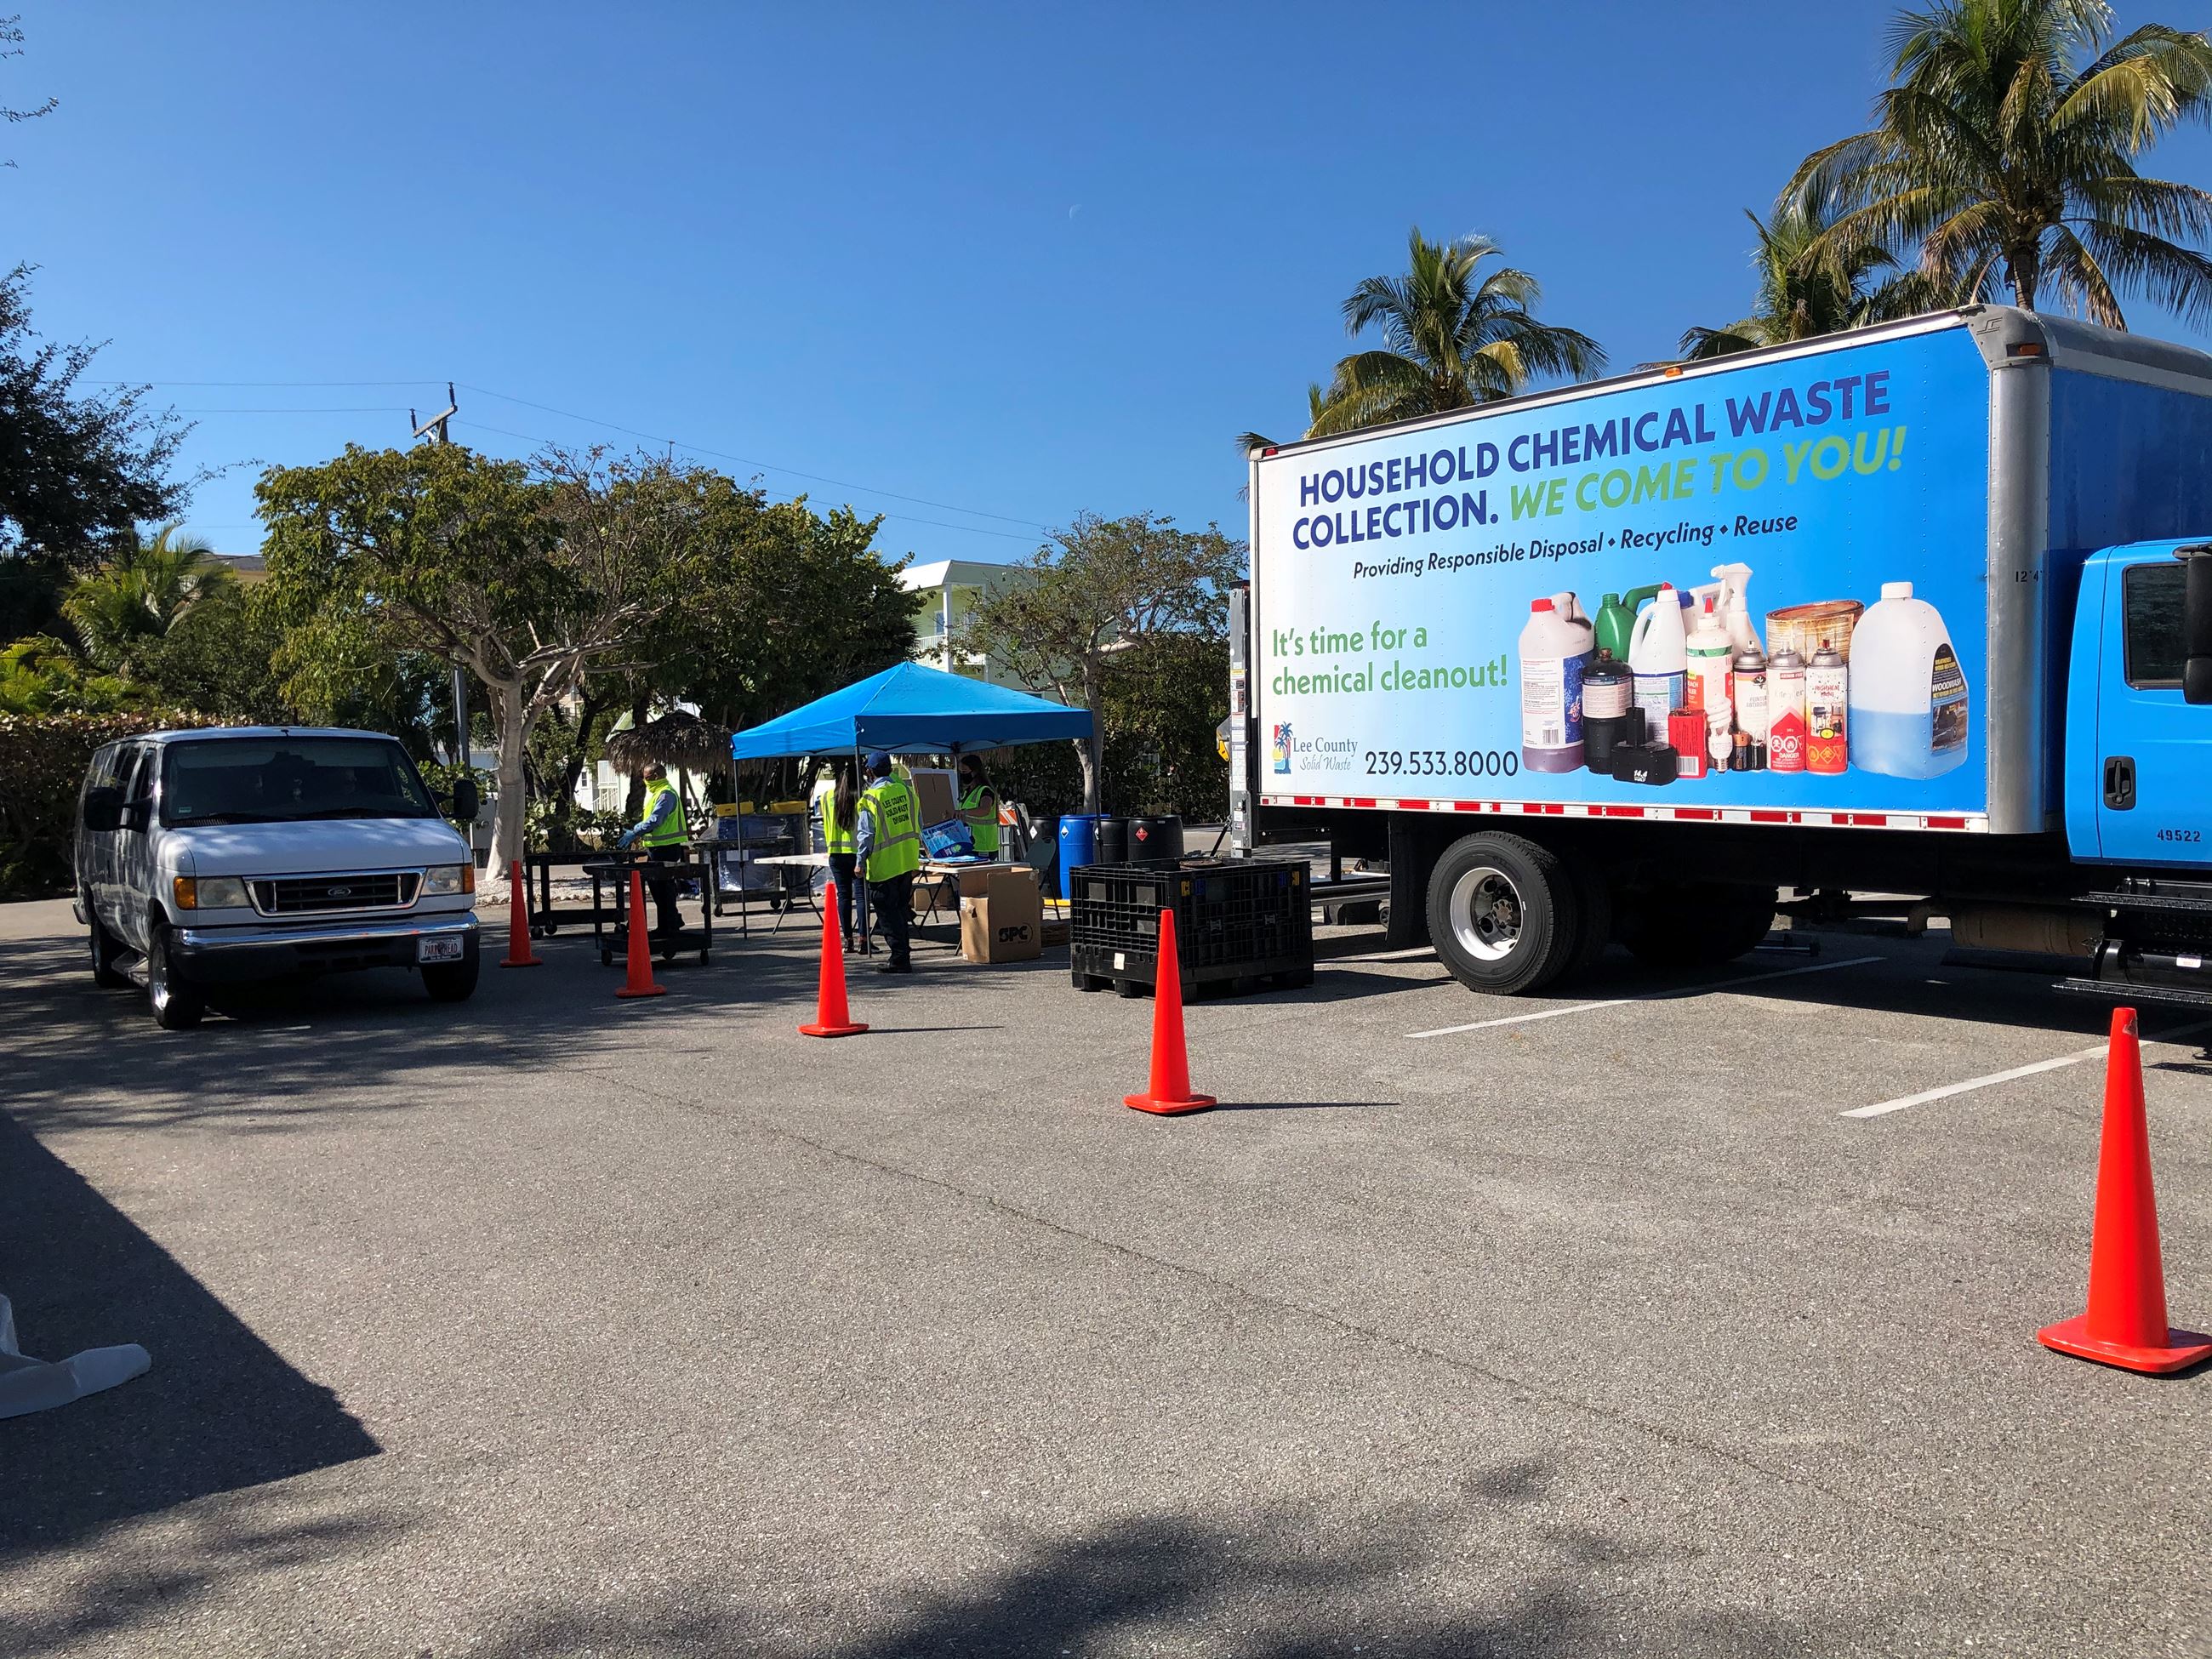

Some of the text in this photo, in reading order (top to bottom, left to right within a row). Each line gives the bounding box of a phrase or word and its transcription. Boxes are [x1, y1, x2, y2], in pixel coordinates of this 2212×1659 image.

[1300, 369, 1890, 507] HOUSEHOLD CHEMICAL WASTE
[1293, 425, 1907, 550] COLLECTION. WE COME TO YOU!
[1353, 515, 1799, 579] Providing Responsible Disposal Recycling Reuse
[1273, 620, 1428, 657] It's time for a
[1272, 661, 1373, 696] chemical
[1380, 653, 1508, 692] cleanout!
[1292, 737, 1359, 757] Lee County
[1299, 753, 1351, 772] Solid Waste
[1365, 750, 1519, 777] 239.533.8000
[882, 799, 892, 809] LEE
[2157, 829, 2201, 842] 49522
[999, 925, 1028, 942] SPC
